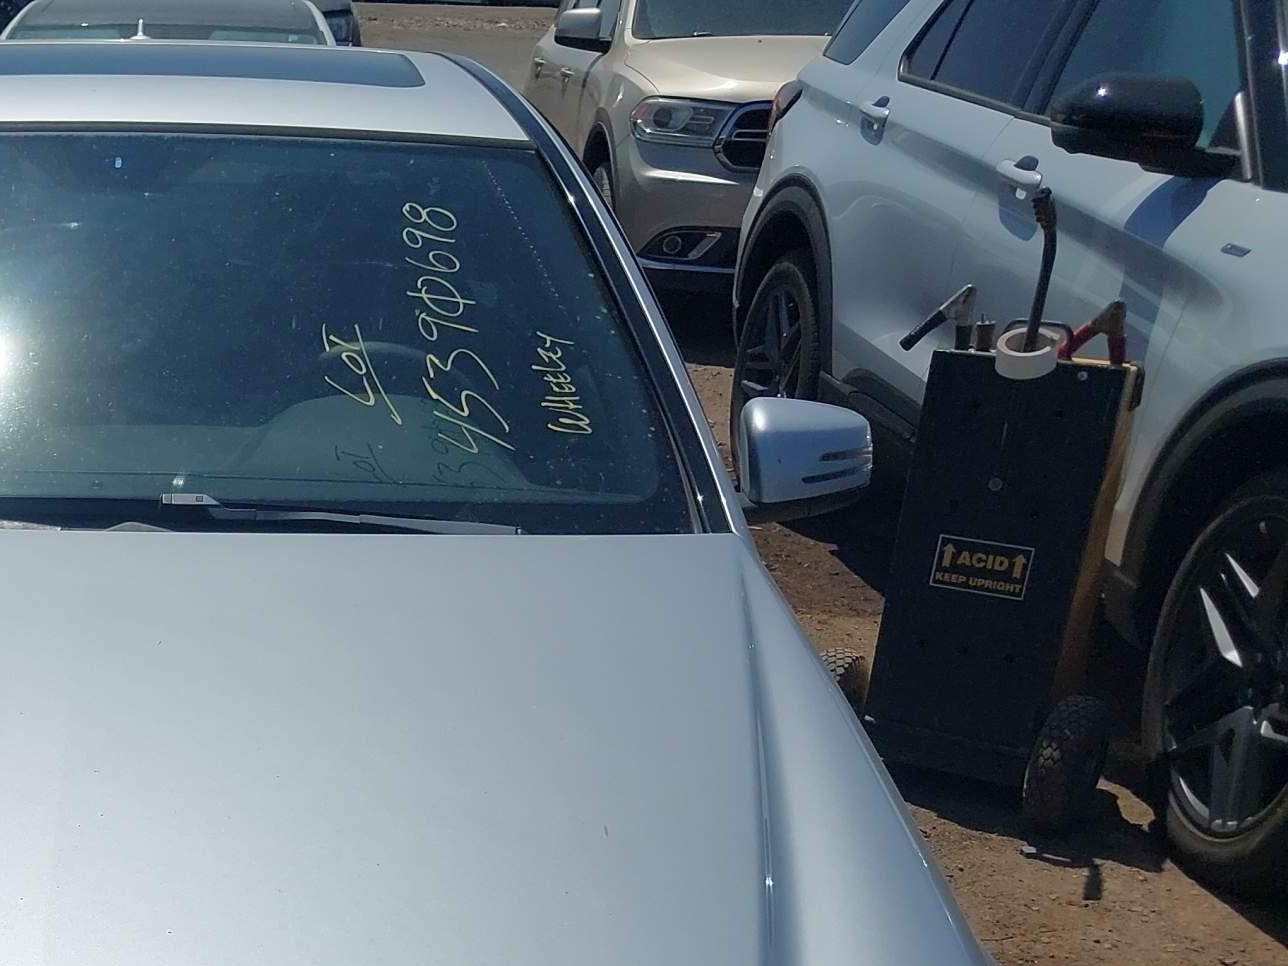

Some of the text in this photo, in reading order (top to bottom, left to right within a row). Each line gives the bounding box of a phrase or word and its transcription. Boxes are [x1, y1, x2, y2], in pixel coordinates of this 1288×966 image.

[402, 202, 515, 454] 45390698
[956, 551, 1009, 571] ACID
[935, 571, 1023, 592] KEEP UPRIGHT
